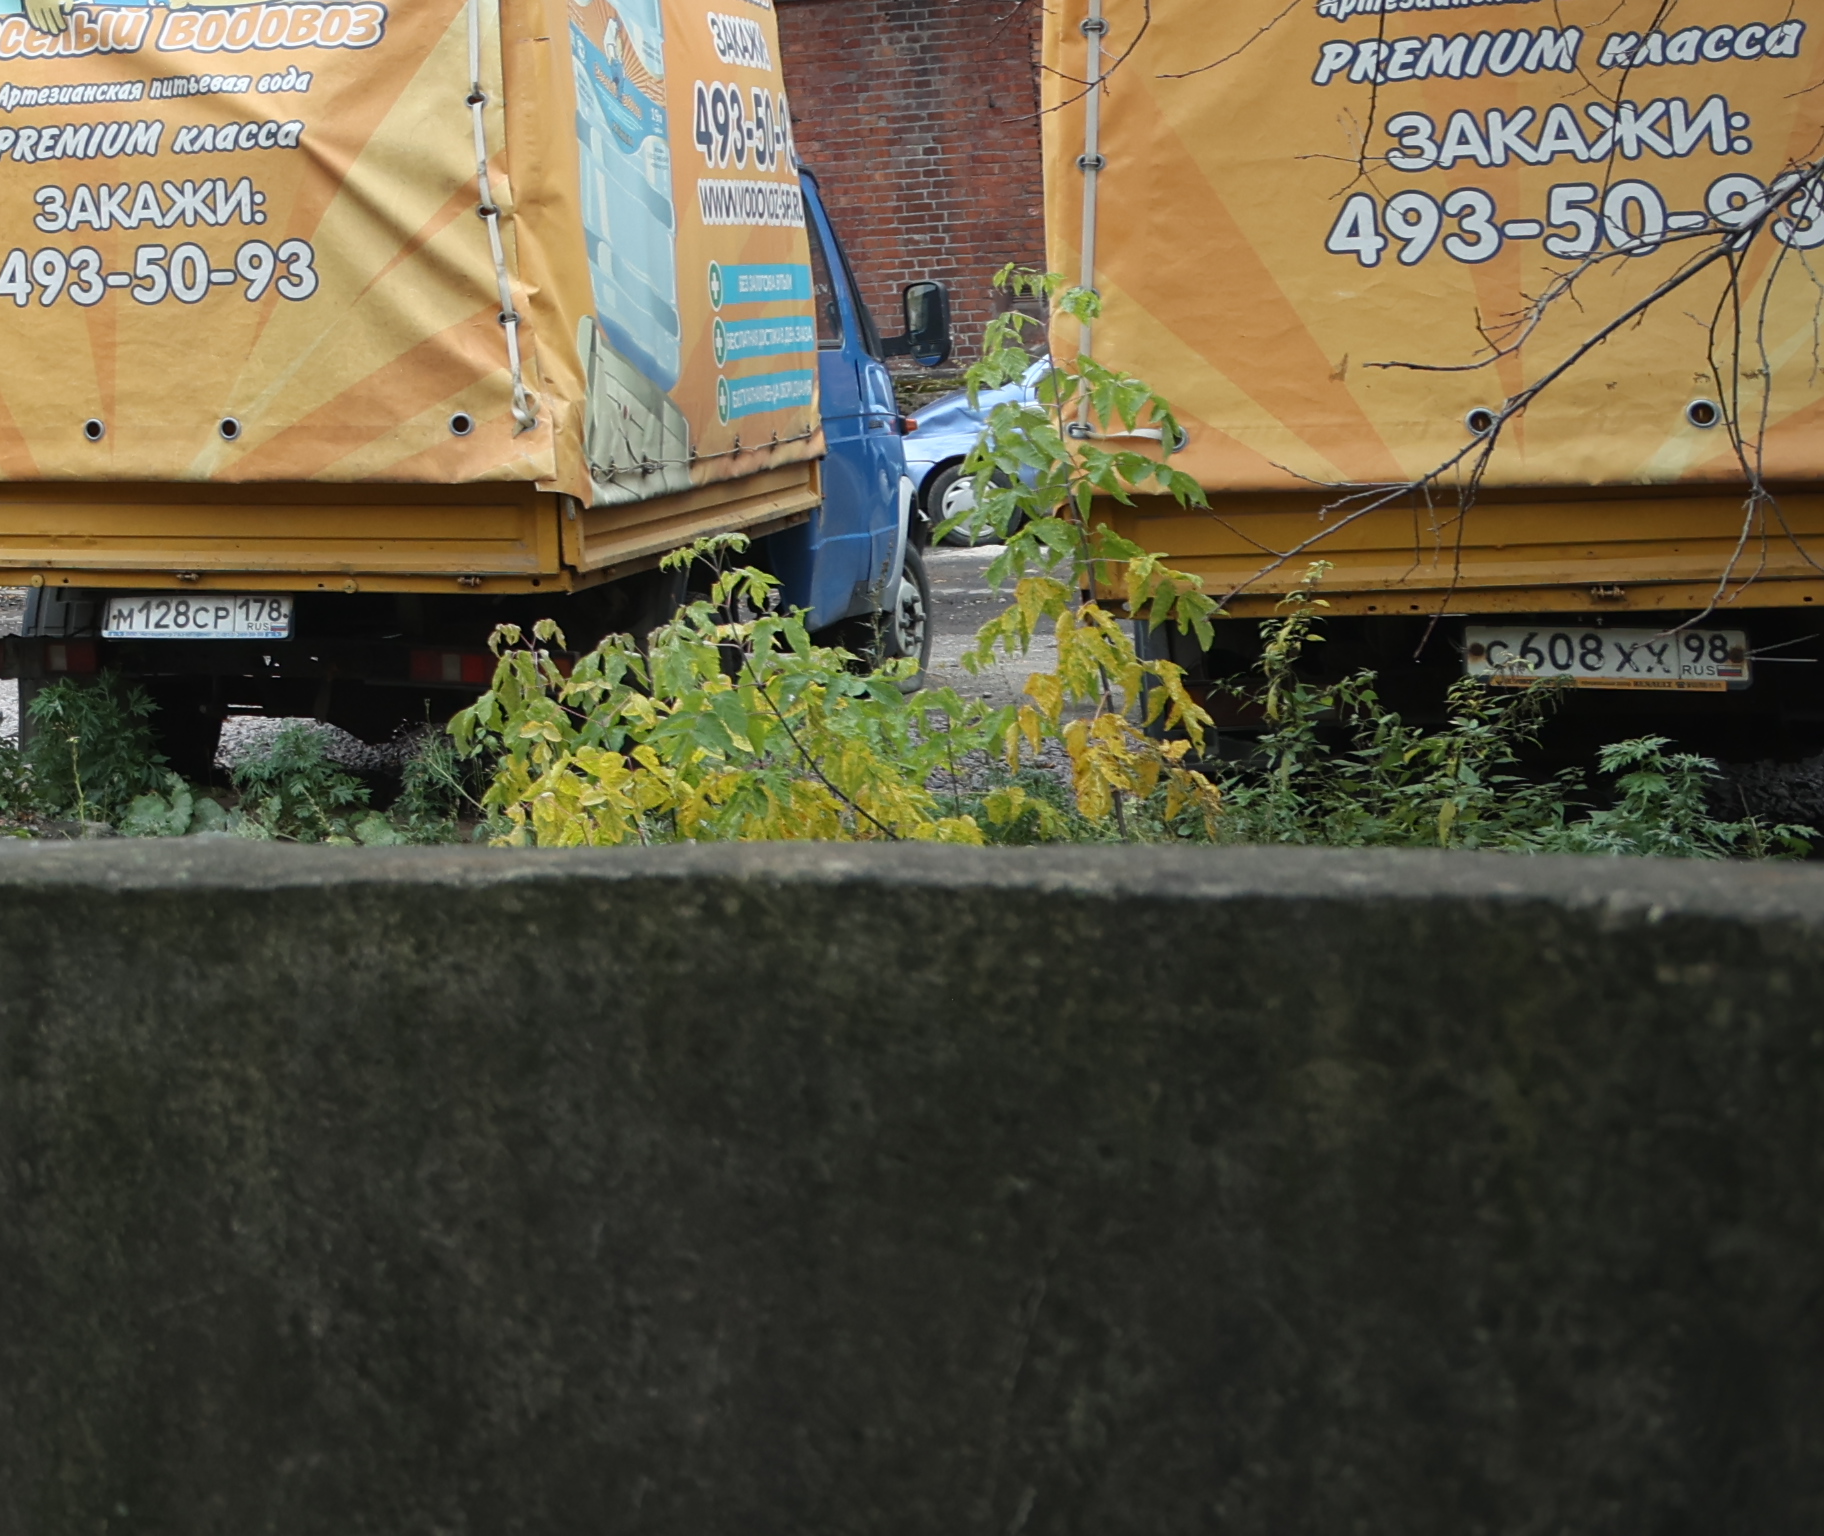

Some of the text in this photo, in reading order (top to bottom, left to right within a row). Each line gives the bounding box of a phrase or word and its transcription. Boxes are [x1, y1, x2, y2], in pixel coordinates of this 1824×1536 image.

[155, 0, 388, 52] водовоз
[1312, 19, 1806, 87] PREMIUM класса
[149, 73, 250, 100] питьевая
[257, 65, 312, 93] вода
[171, 119, 305, 154] класса
[1384, 93, 1753, 171] ЗАКАЖИ:
[33, 176, 268, 232] ЗАКАЖИ:
[1324, 170, 1824, 267] 493-50-93
[238, 598, 283, 622] 178
[247, 622, 270, 631] RUS
[1684, 633, 1730, 663] 98
[1682, 665, 1716, 676] RUS
